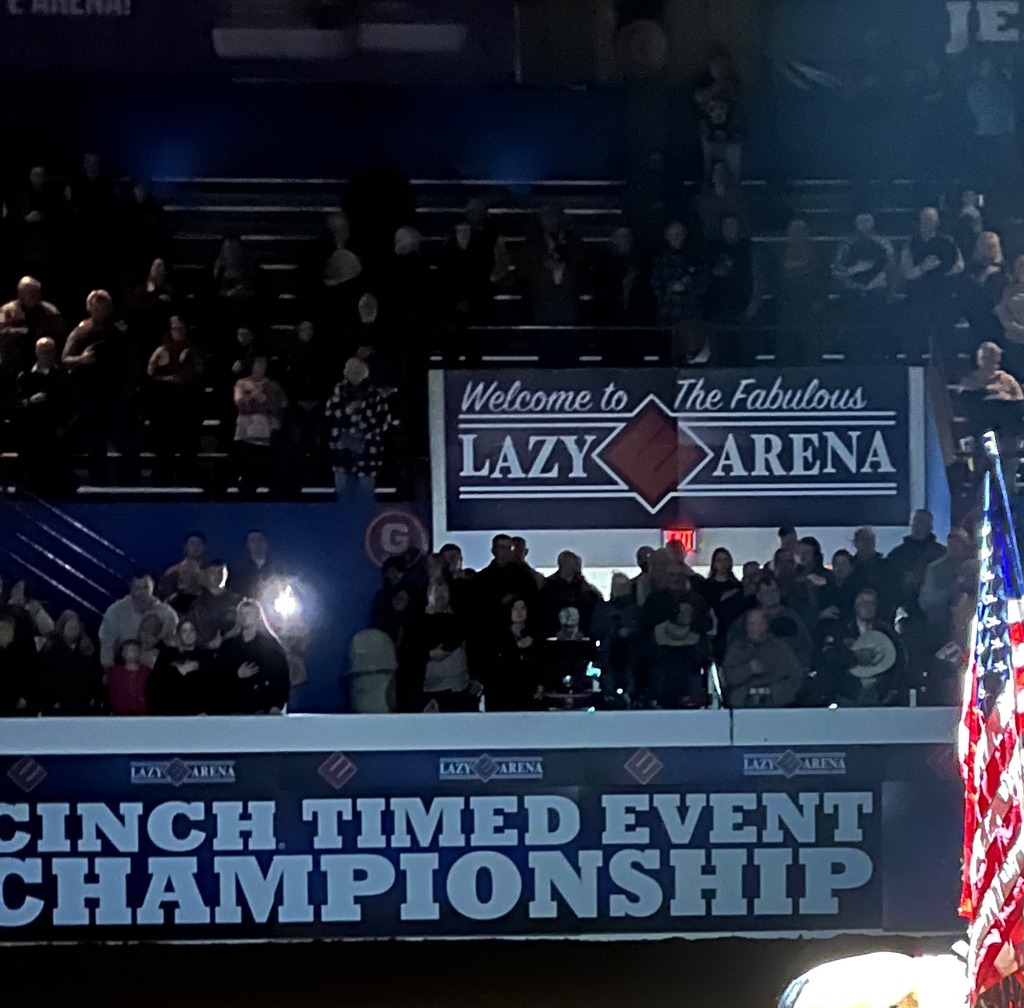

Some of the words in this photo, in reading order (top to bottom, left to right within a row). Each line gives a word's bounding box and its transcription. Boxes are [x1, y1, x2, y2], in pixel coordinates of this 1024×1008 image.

[461, 380, 593, 412] Welcome
[600, 381, 628, 411] to
[674, 377, 723, 410] The
[730, 376, 867, 410] Fabulous
[458, 434, 597, 478] LAZY
[713, 430, 897, 477] ARENA
[381, 523, 409, 554] G
[131, 766, 162, 779] LAZY
[191, 765, 235, 778] ARENA
[440, 762, 471, 774] LAZY
[500, 761, 543, 774] ARENA
[744, 758, 775, 770] LAZY
[802, 757, 846, 769] ARENA
[302, 794, 581, 850] TIMED
[601, 791, 873, 845] EVENT
[0, 847, 874, 927] CHAMPIONSHIP
